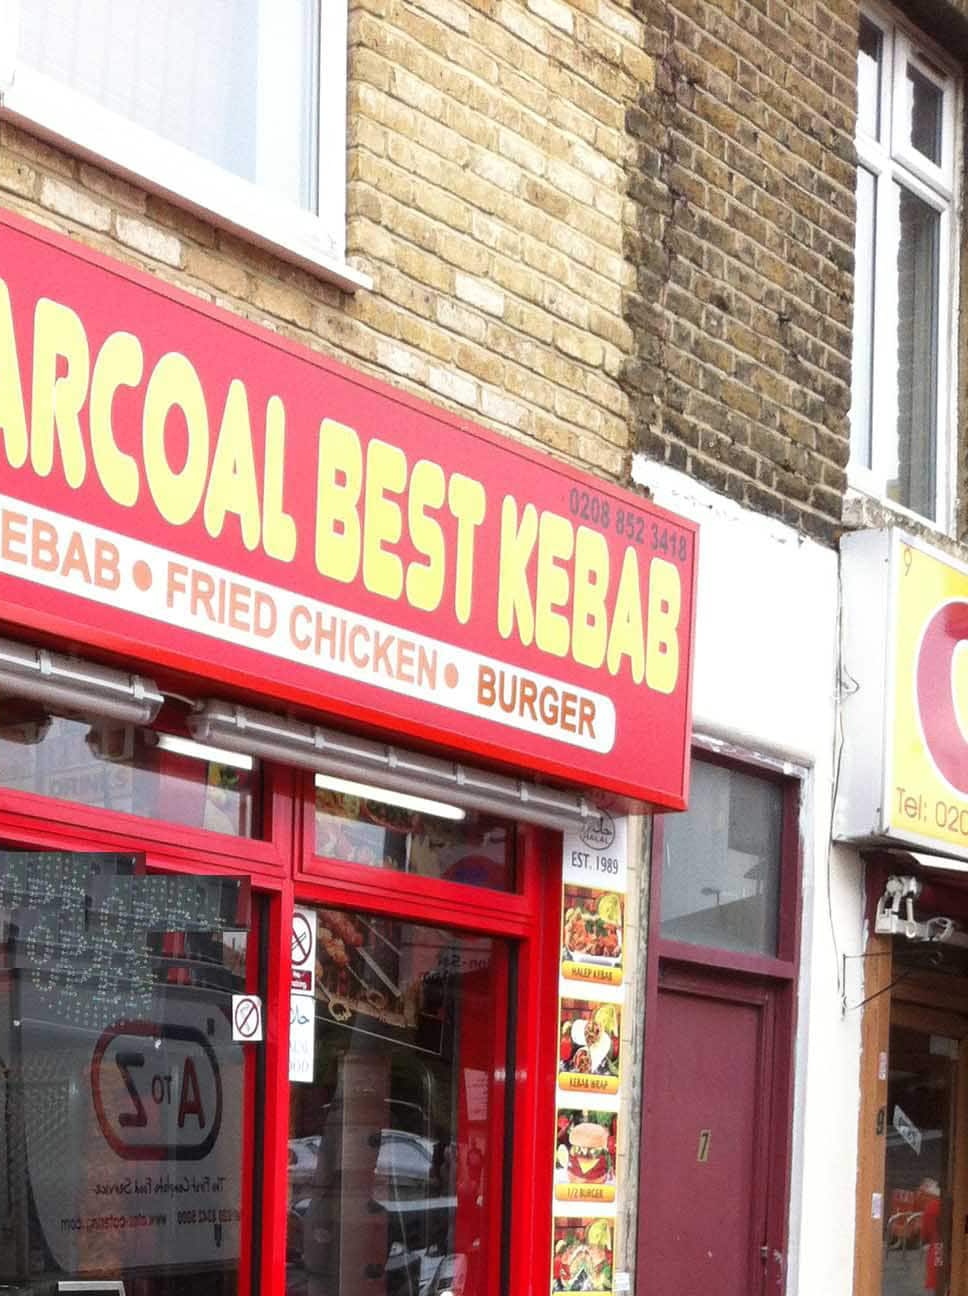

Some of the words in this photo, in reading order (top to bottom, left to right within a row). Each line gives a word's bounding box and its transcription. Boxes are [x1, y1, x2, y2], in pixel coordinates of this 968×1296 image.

[569, 487, 610, 529] 0208
[614, 506, 645, 545] 852
[650, 521, 688, 562] 3418
[314, 417, 486, 624] BEST
[497, 494, 682, 694] KEBAB
[165, 560, 277, 639] FRIED
[288, 604, 437, 690] CHICKEN
[476, 665, 597, 738] BURGER
[896, 786, 927, 823] Tel:
[571, 851, 592, 870] EST.
[595, 856, 618, 875] 1989
[580, 1187, 604, 1199] BURGER
